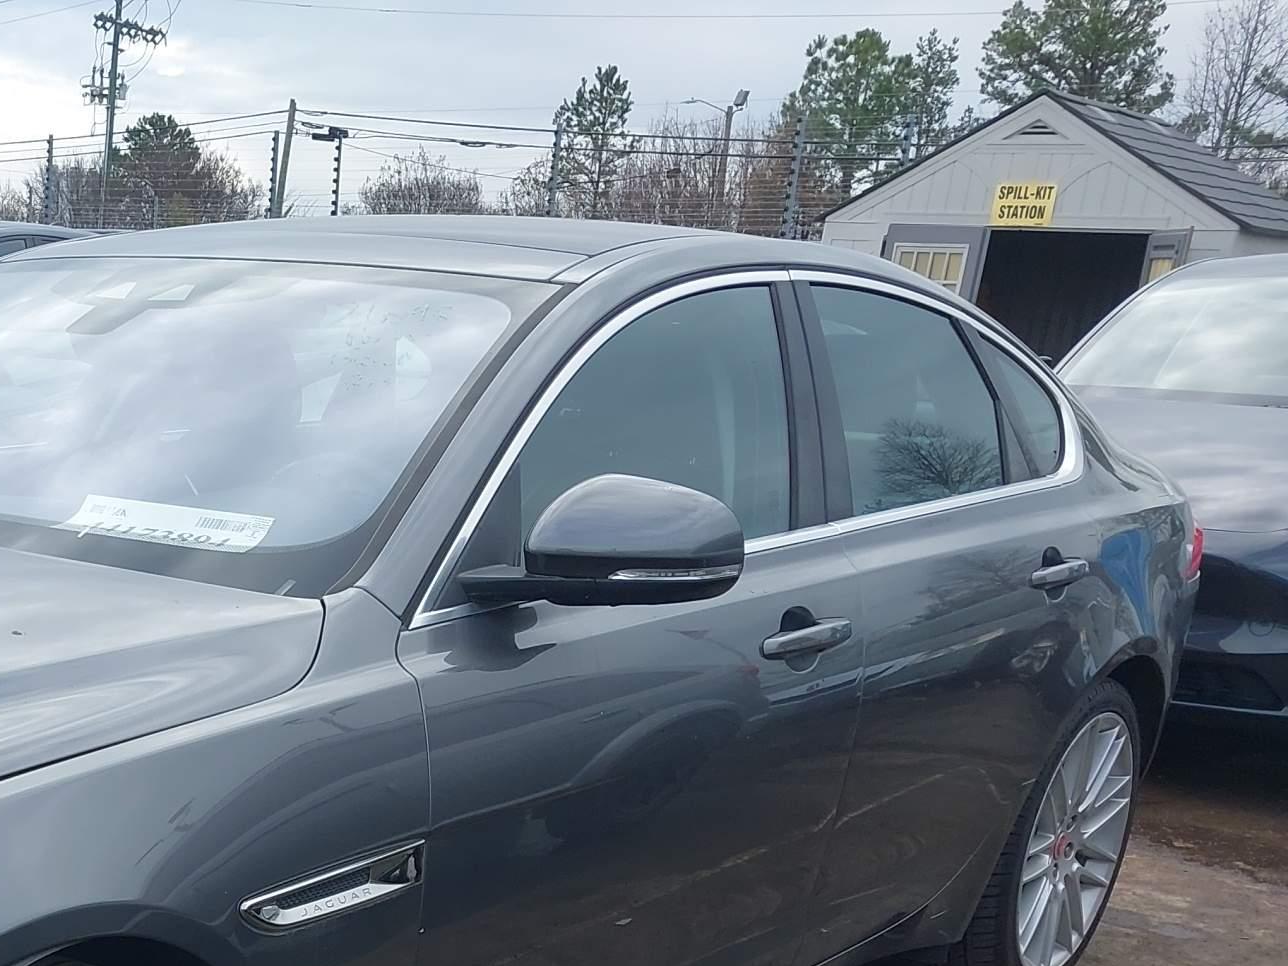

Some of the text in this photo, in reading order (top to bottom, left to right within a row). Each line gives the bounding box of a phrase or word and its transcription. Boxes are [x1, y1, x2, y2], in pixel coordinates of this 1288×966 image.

[998, 185, 1055, 200] SPILL-KIT
[998, 205, 1046, 219] STATION
[300, 887, 372, 918] JAGUAR
